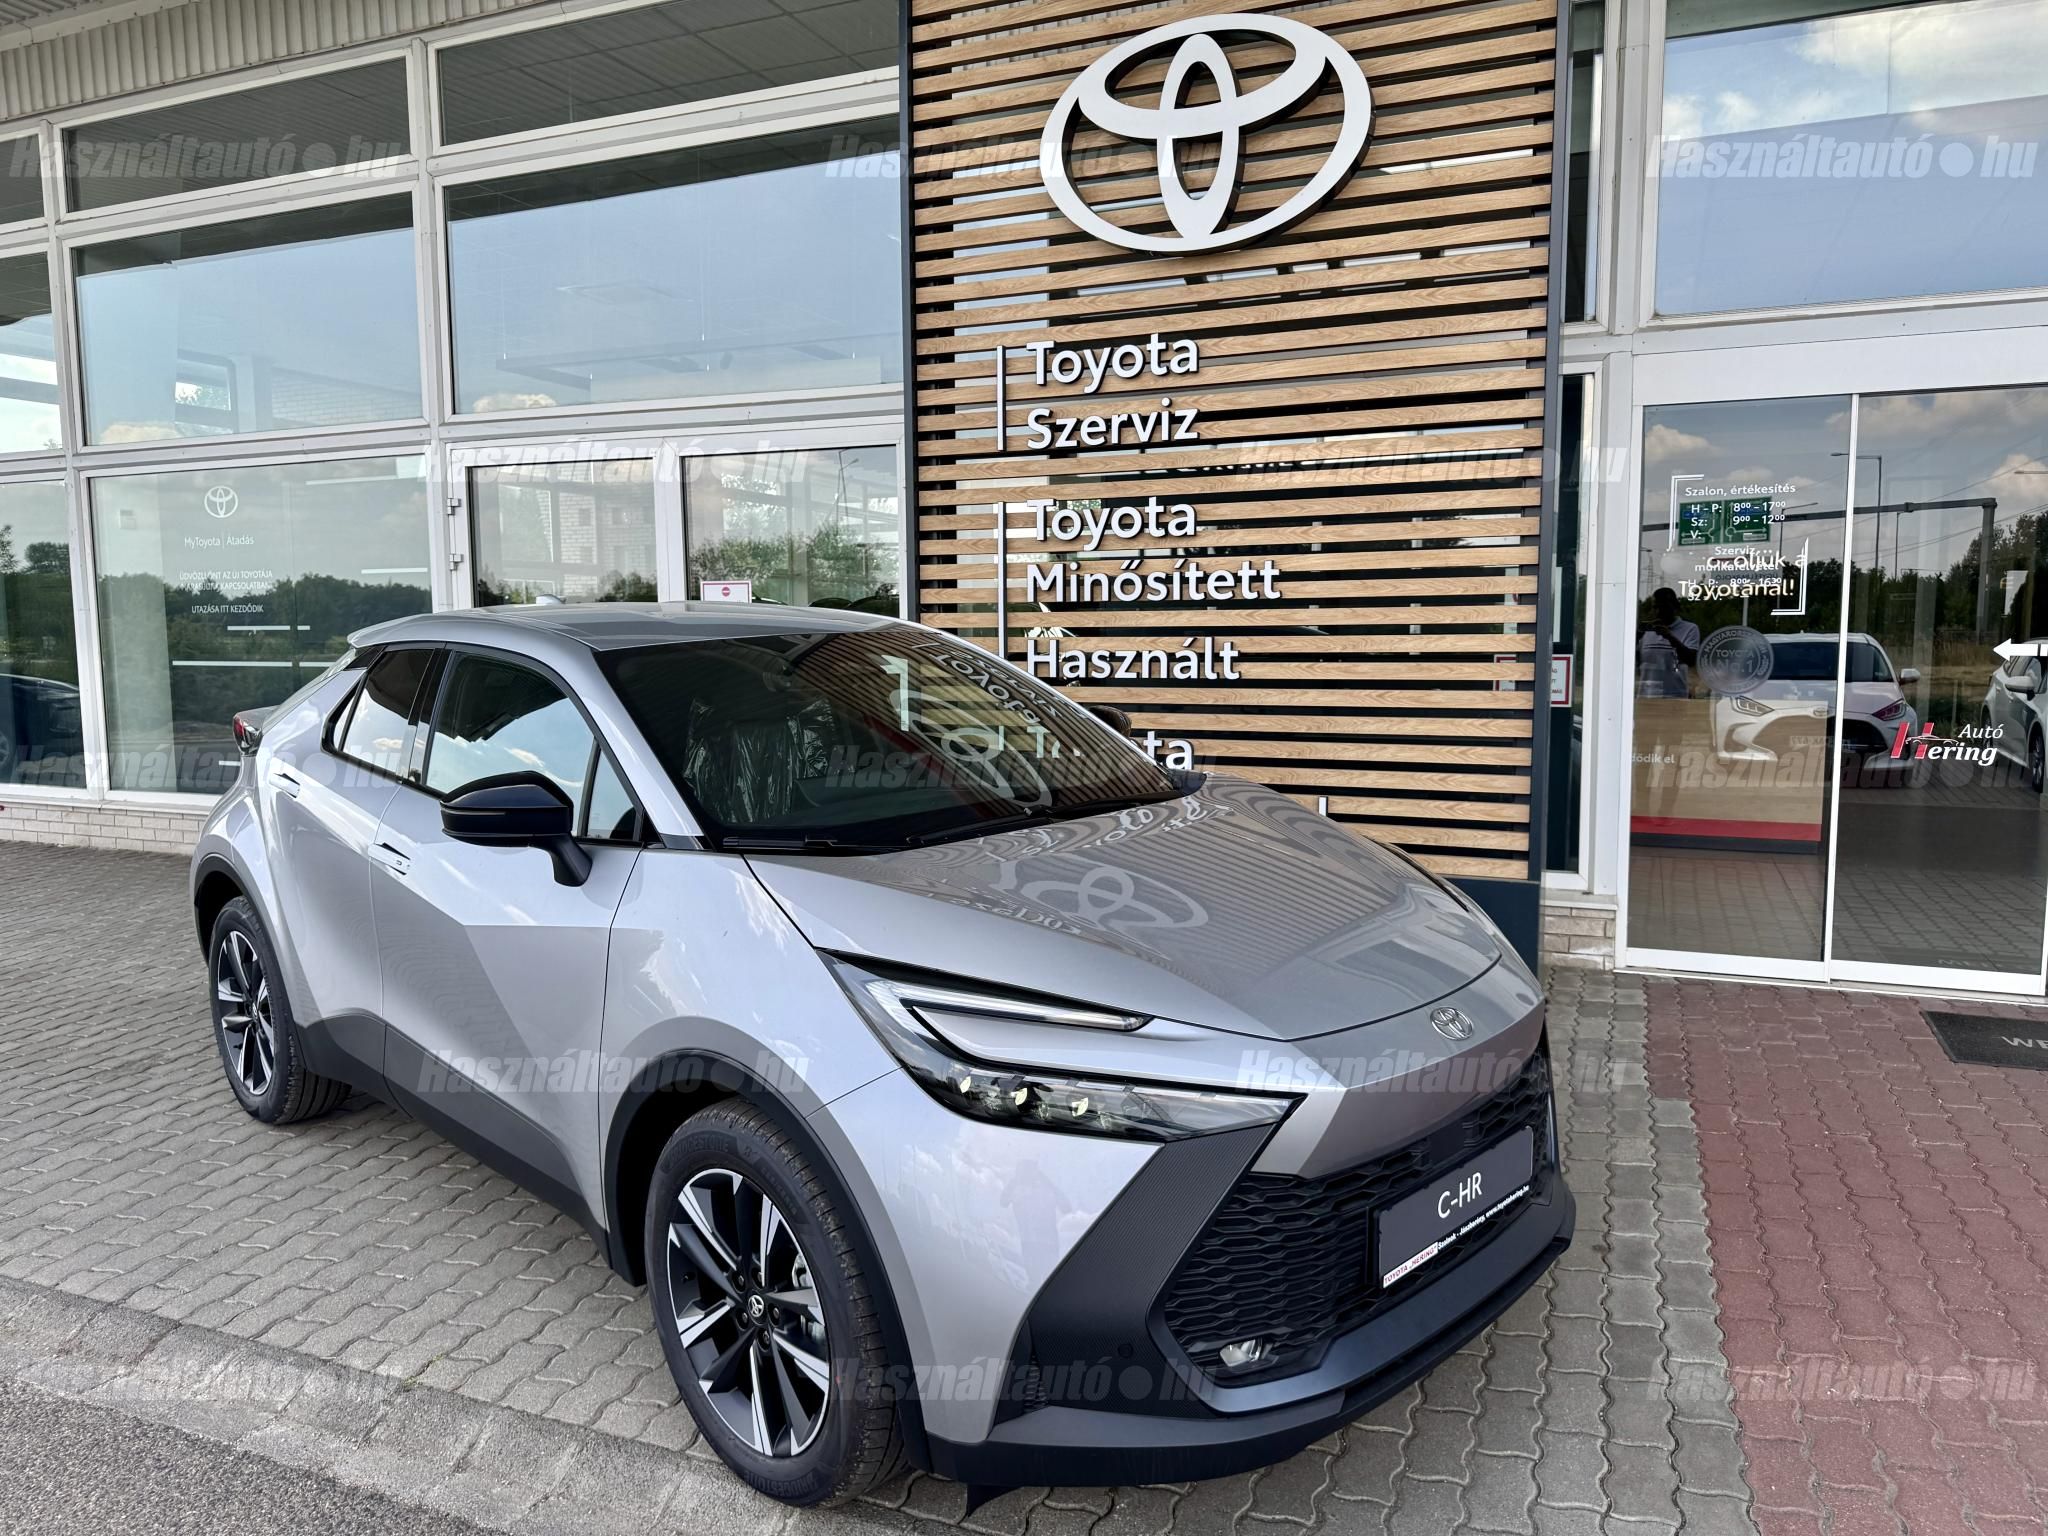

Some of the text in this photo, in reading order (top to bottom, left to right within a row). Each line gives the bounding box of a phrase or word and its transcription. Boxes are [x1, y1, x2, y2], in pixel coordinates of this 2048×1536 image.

[1026, 332, 1200, 393] Toyota
[1027, 397, 1200, 449] Szerviz
[1685, 483, 1796, 497] Szalon, értékesítés
[1026, 496, 1197, 551] Toyota
[1690, 517, 1708, 527] Sz:
[1691, 504, 1701, 514] H
[184, 536, 221, 549] MyToyota
[1026, 559, 1283, 603] Minősített
[191, 603, 220, 614] UTAZÁSA
[230, 602, 264, 614] KEZDŐDIK
[1027, 636, 1242, 681] Használt
[1890, 722, 1998, 767] Hering
[1957, 723, 2005, 739] Autó
[1437, 1172, 1482, 1219] C-HR
[1384, 1264, 1409, 1285] TOYOTA
